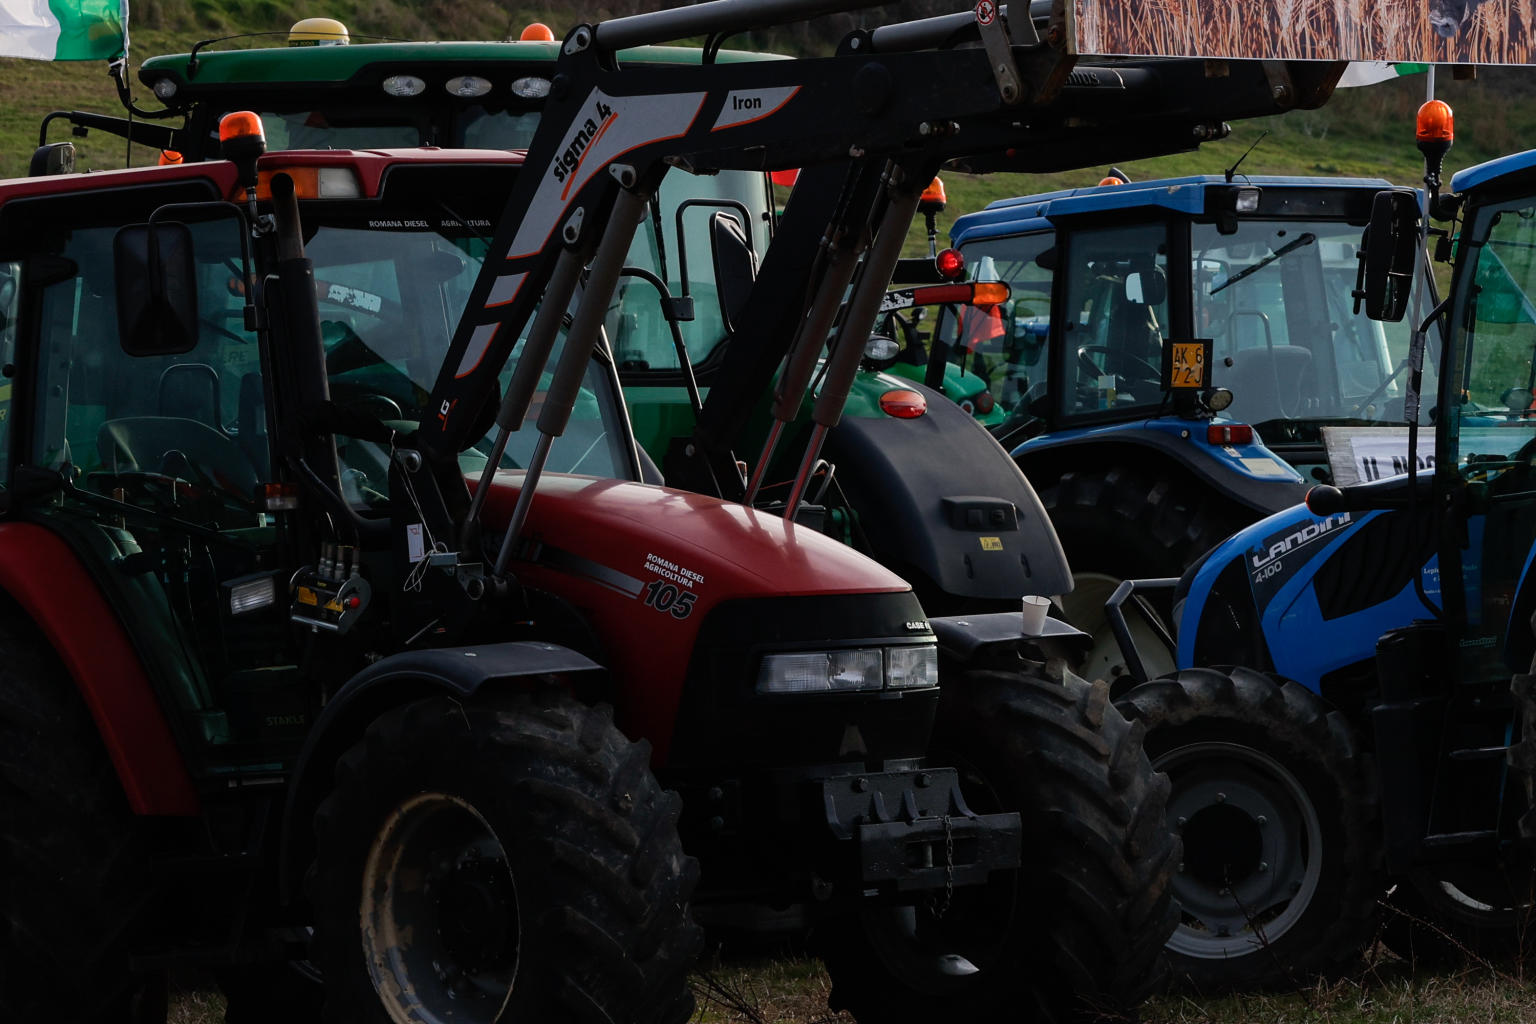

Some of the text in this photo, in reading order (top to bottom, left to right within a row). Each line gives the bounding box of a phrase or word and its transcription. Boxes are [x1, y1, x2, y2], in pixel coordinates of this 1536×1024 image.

[733, 95, 762, 110] Iron
[554, 101, 612, 183] sigma 4
[368, 220, 402, 228] ROMANA
[441, 219, 491, 227] AGRILTURA
[1174, 347, 1203, 364] AK 6
[643, 561, 693, 588] AGRICOLTURA
[646, 553, 704, 584] ROMANA DIESEL
[1255, 560, 1282, 584] 4-100
[644, 579, 698, 620] 105
[906, 621, 925, 630] CASE
